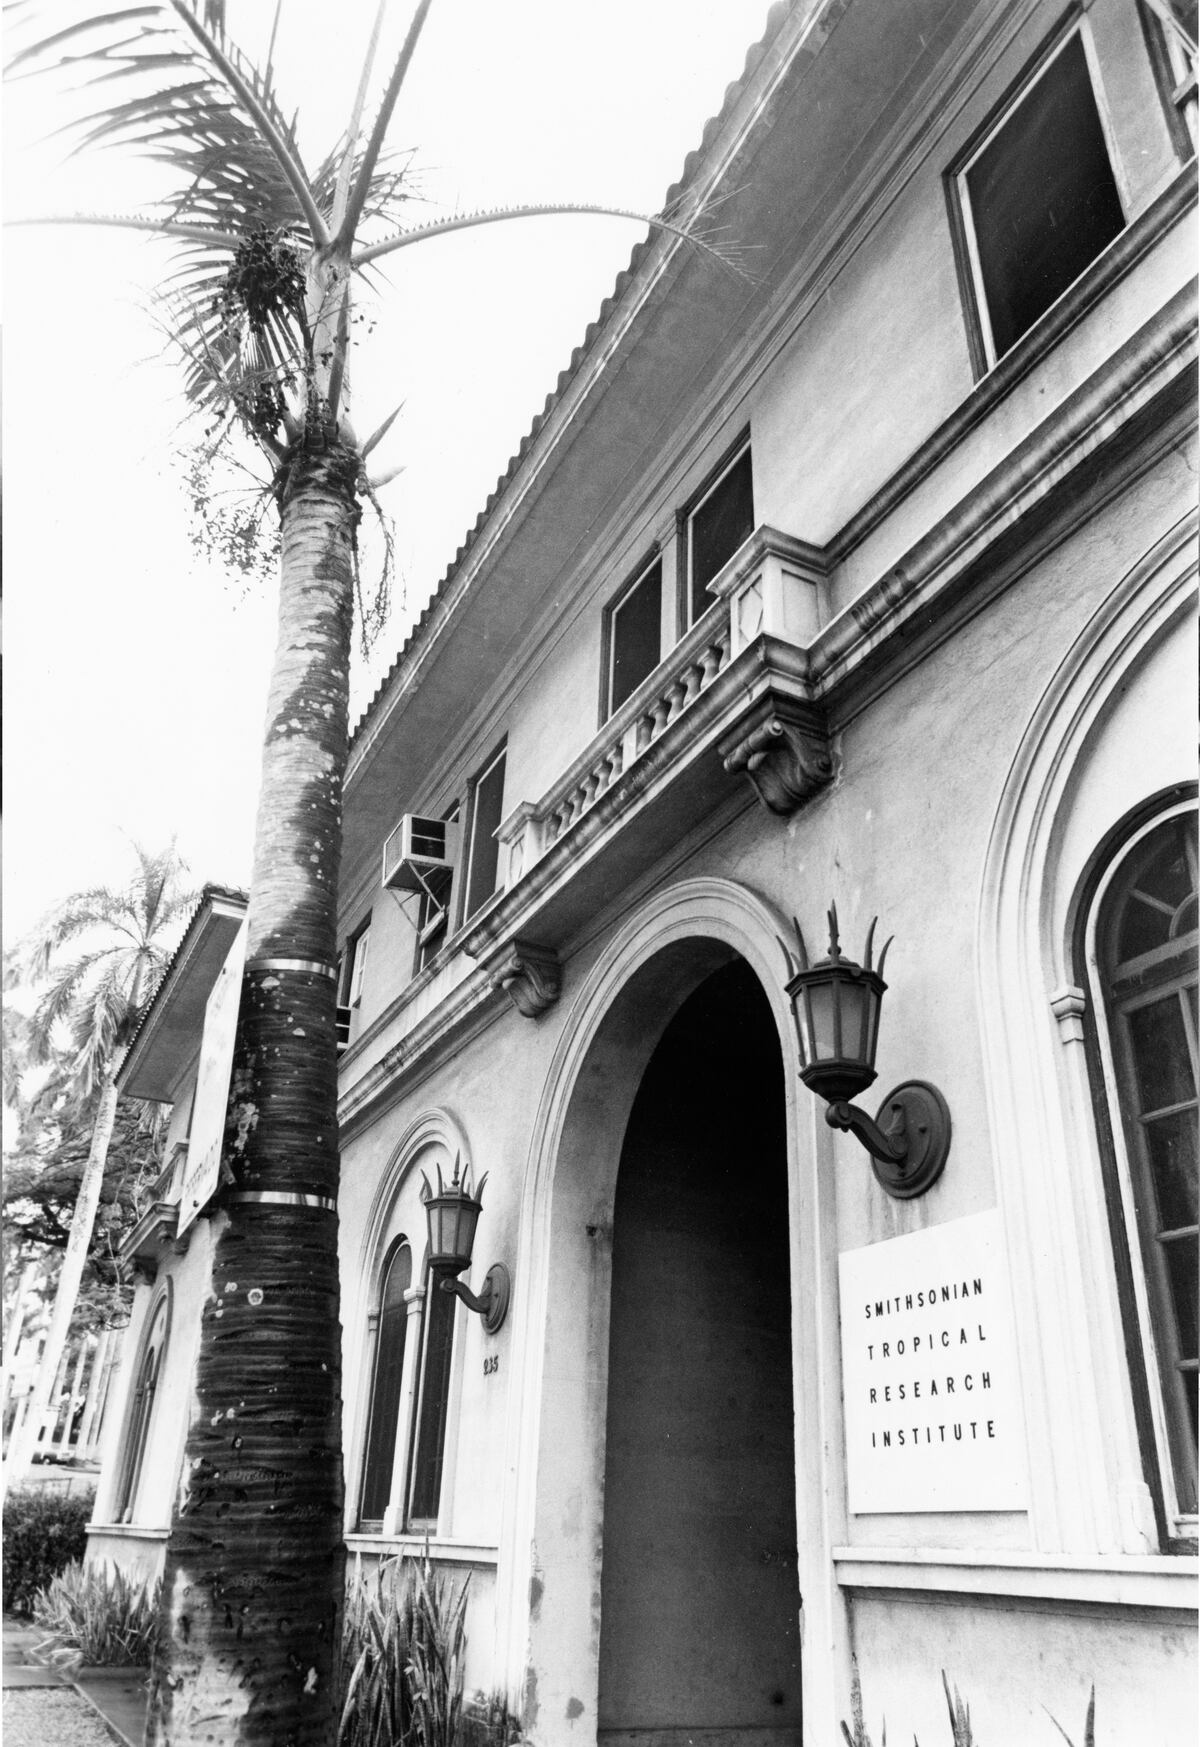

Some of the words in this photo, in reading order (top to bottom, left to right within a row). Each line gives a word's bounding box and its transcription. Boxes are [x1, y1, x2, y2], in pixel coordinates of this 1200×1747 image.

[865, 1278, 982, 1319] SMITHSONIAN
[867, 1324, 986, 1360] TROPICAL
[869, 1371, 991, 1404] RESEARCH
[872, 1420, 995, 1448] INSTITUTE
